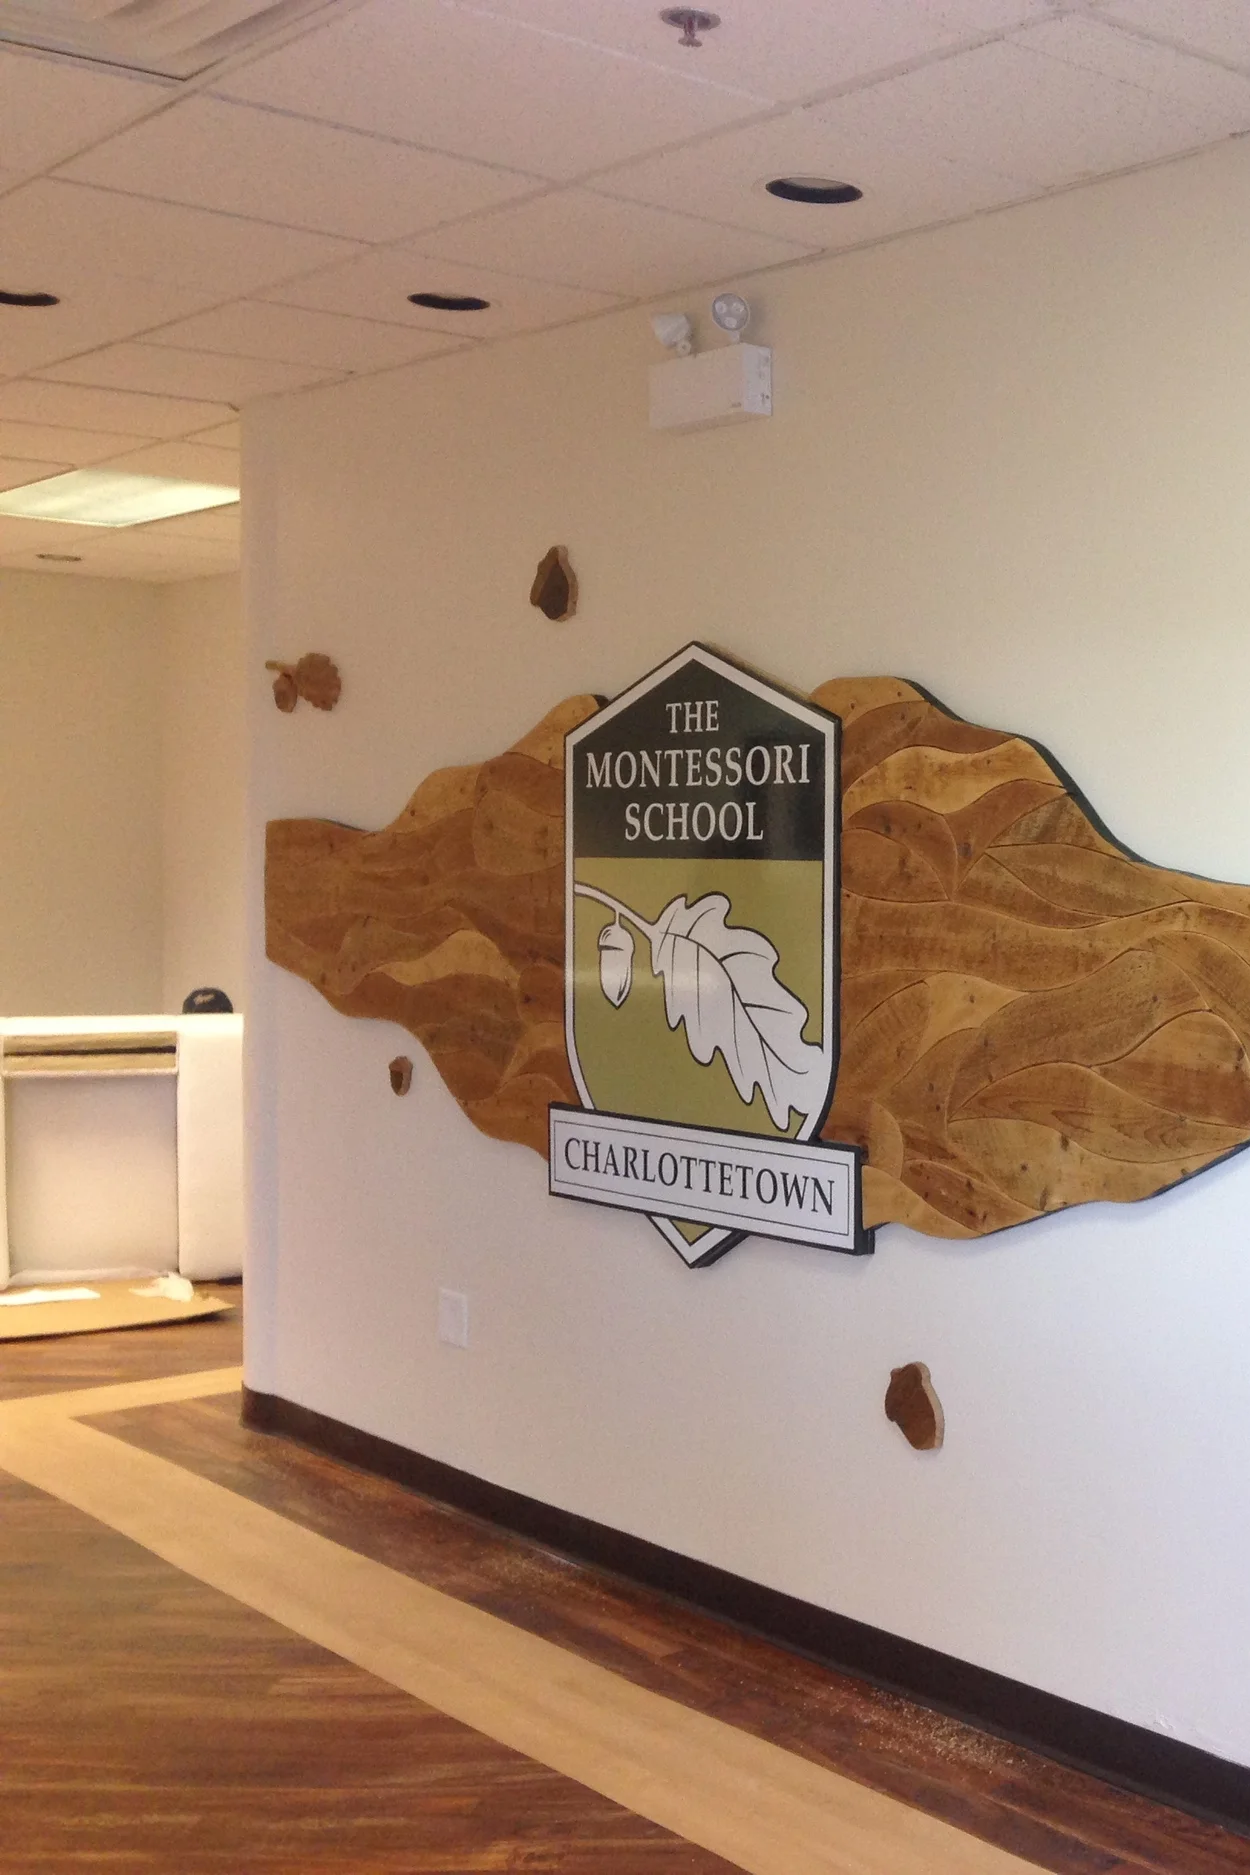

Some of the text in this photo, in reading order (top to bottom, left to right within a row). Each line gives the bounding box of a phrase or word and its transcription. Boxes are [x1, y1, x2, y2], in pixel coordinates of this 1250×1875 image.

[665, 700, 720, 734] THE
[586, 743, 811, 789] MONTESSORI
[624, 801, 764, 842] SCHOOL
[564, 1137, 835, 1216] CHARLOTTETOWN
